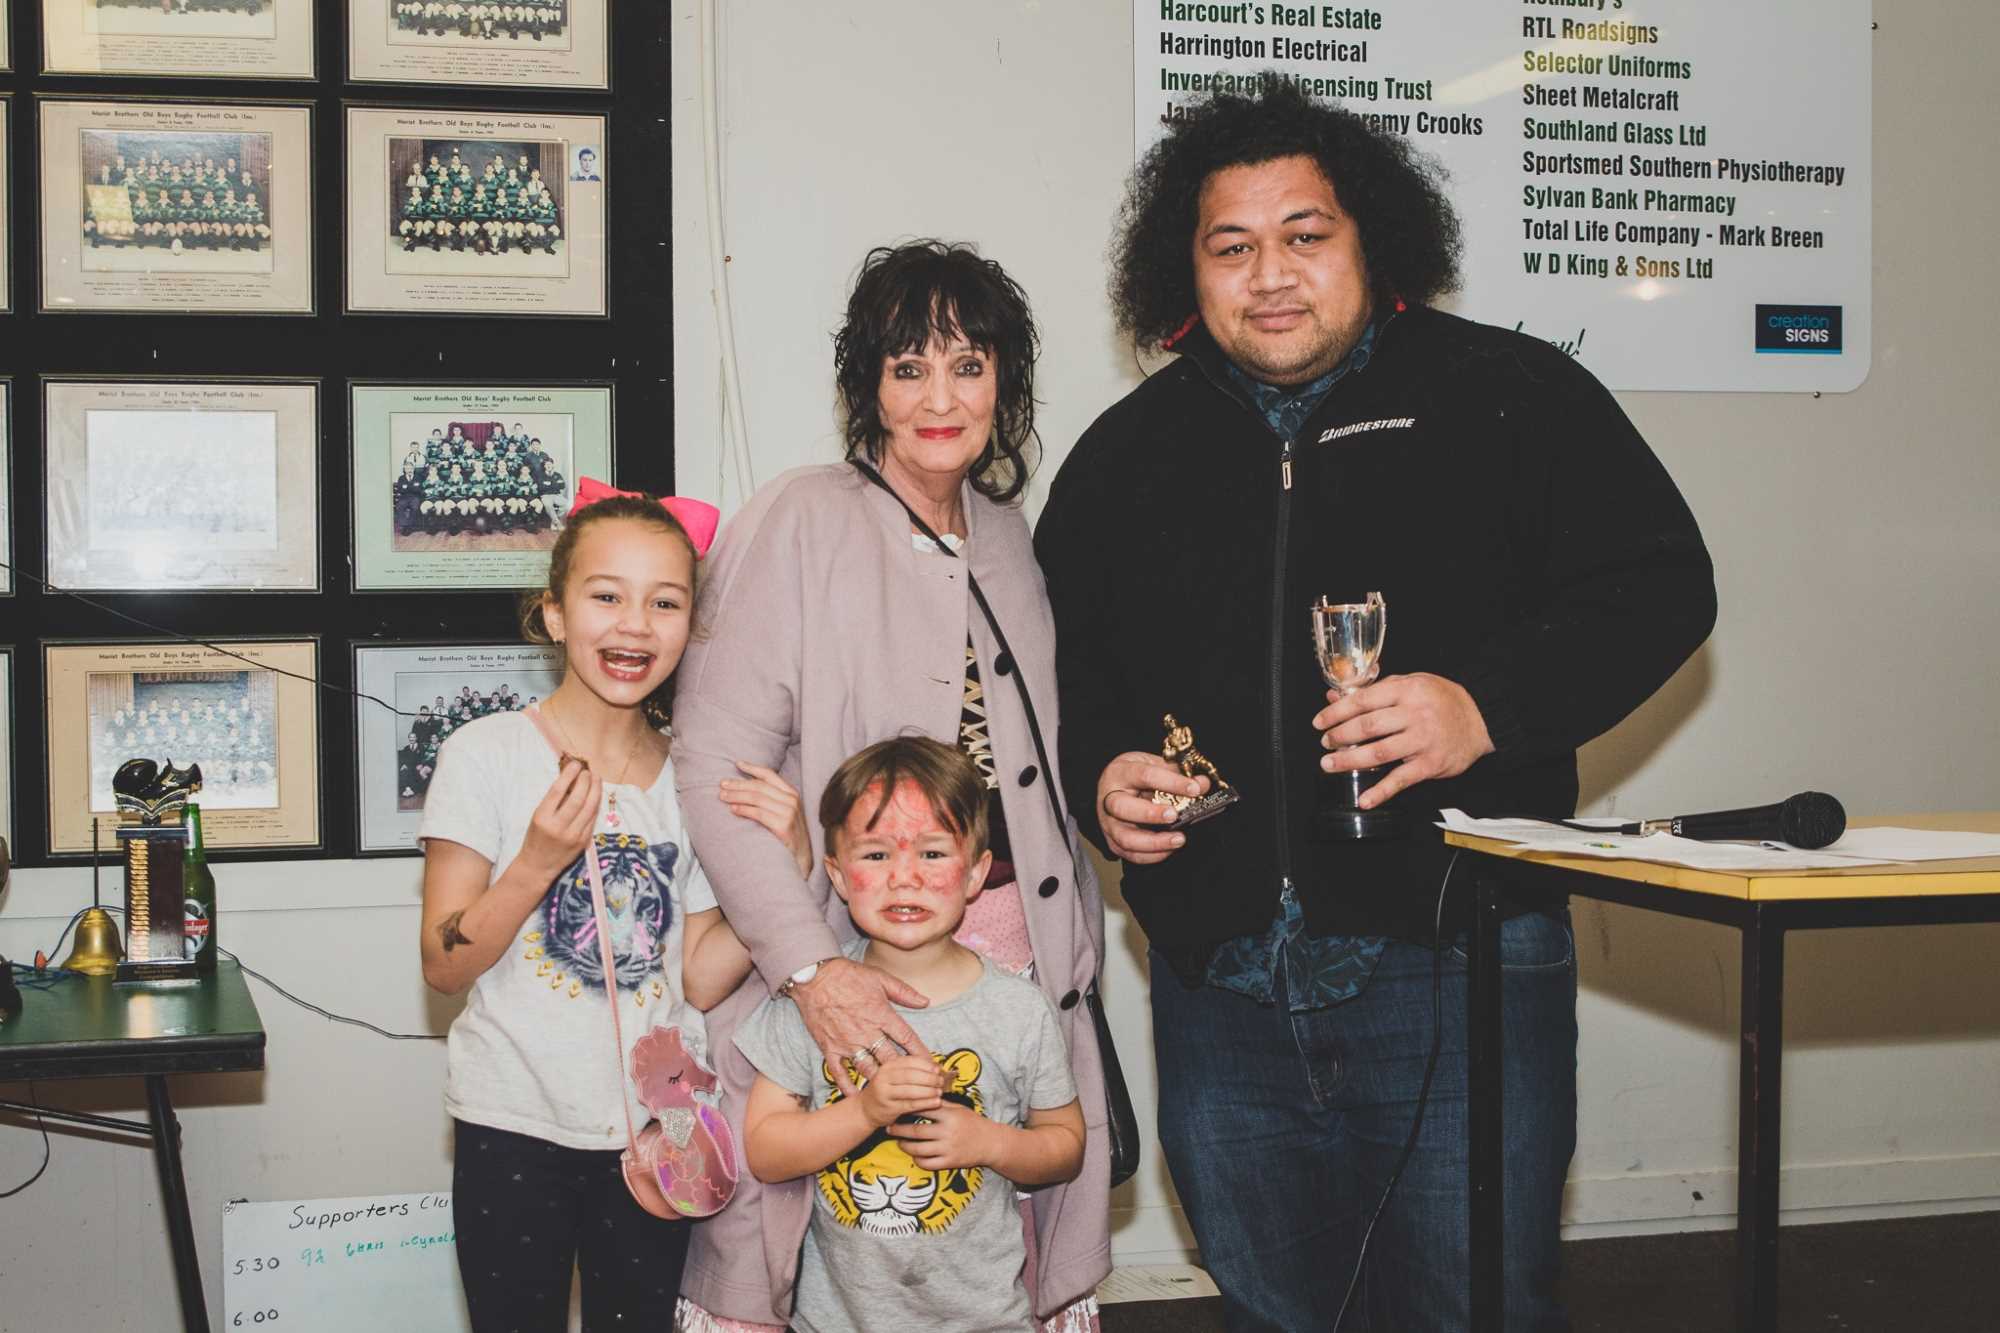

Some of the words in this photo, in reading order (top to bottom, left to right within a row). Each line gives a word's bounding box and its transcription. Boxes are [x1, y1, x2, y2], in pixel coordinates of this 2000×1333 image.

[1160, 0, 1265, 25] Harcourt's
[1271, 6, 1316, 28] Real
[1322, 6, 1382, 31] Estate
[1523, 17, 1556, 39] RTL
[1562, 19, 1658, 45] Roadsigns
[1160, 31, 1266, 59] Harrington
[1272, 37, 1368, 63] Electrical
[1523, 50, 1604, 76] Selector
[1608, 54, 1691, 80] Uniforms
[1384, 77, 1433, 101] Trust
[1523, 84, 1577, 108] Sheet
[1583, 86, 1679, 112] Metalcraft
[1416, 111, 1484, 136] Crooks
[1523, 117, 1618, 143] Southland
[1623, 122, 1674, 146] Glass
[1679, 124, 1707, 147] Ltd
[1523, 151, 1623, 176] Sportsmed
[1629, 154, 1712, 180] Southern
[1717, 158, 1845, 186] Physiotherapy
[1523, 185, 1586, 210] Sylvan
[1591, 187, 1639, 211] Bank
[1643, 189, 1737, 216] Pharmacy
[1522, 218, 1569, 242] Total
[1574, 220, 1609, 243] Life
[1614, 221, 1700, 247] Company
[1719, 225, 1766, 247] Mark
[1771, 226, 1824, 249] Breen
[1523, 252, 1542, 275] W
[1548, 253, 1561, 275] D
[1566, 254, 1609, 278] King
[1615, 255, 1629, 278] &
[1635, 255, 1681, 278] Sons
[1686, 257, 1713, 279] Ltd
[1768, 314, 1830, 329] creation
[1785, 328, 1829, 343] SIGNS
[1318, 418, 1415, 443] BRIDGESTONE
[288, 1202, 409, 1229] Supporters
[419, 1196, 449, 1210] Clu
[232, 1256, 280, 1275] 5.30
[232, 1308, 279, 1327] 6.00
